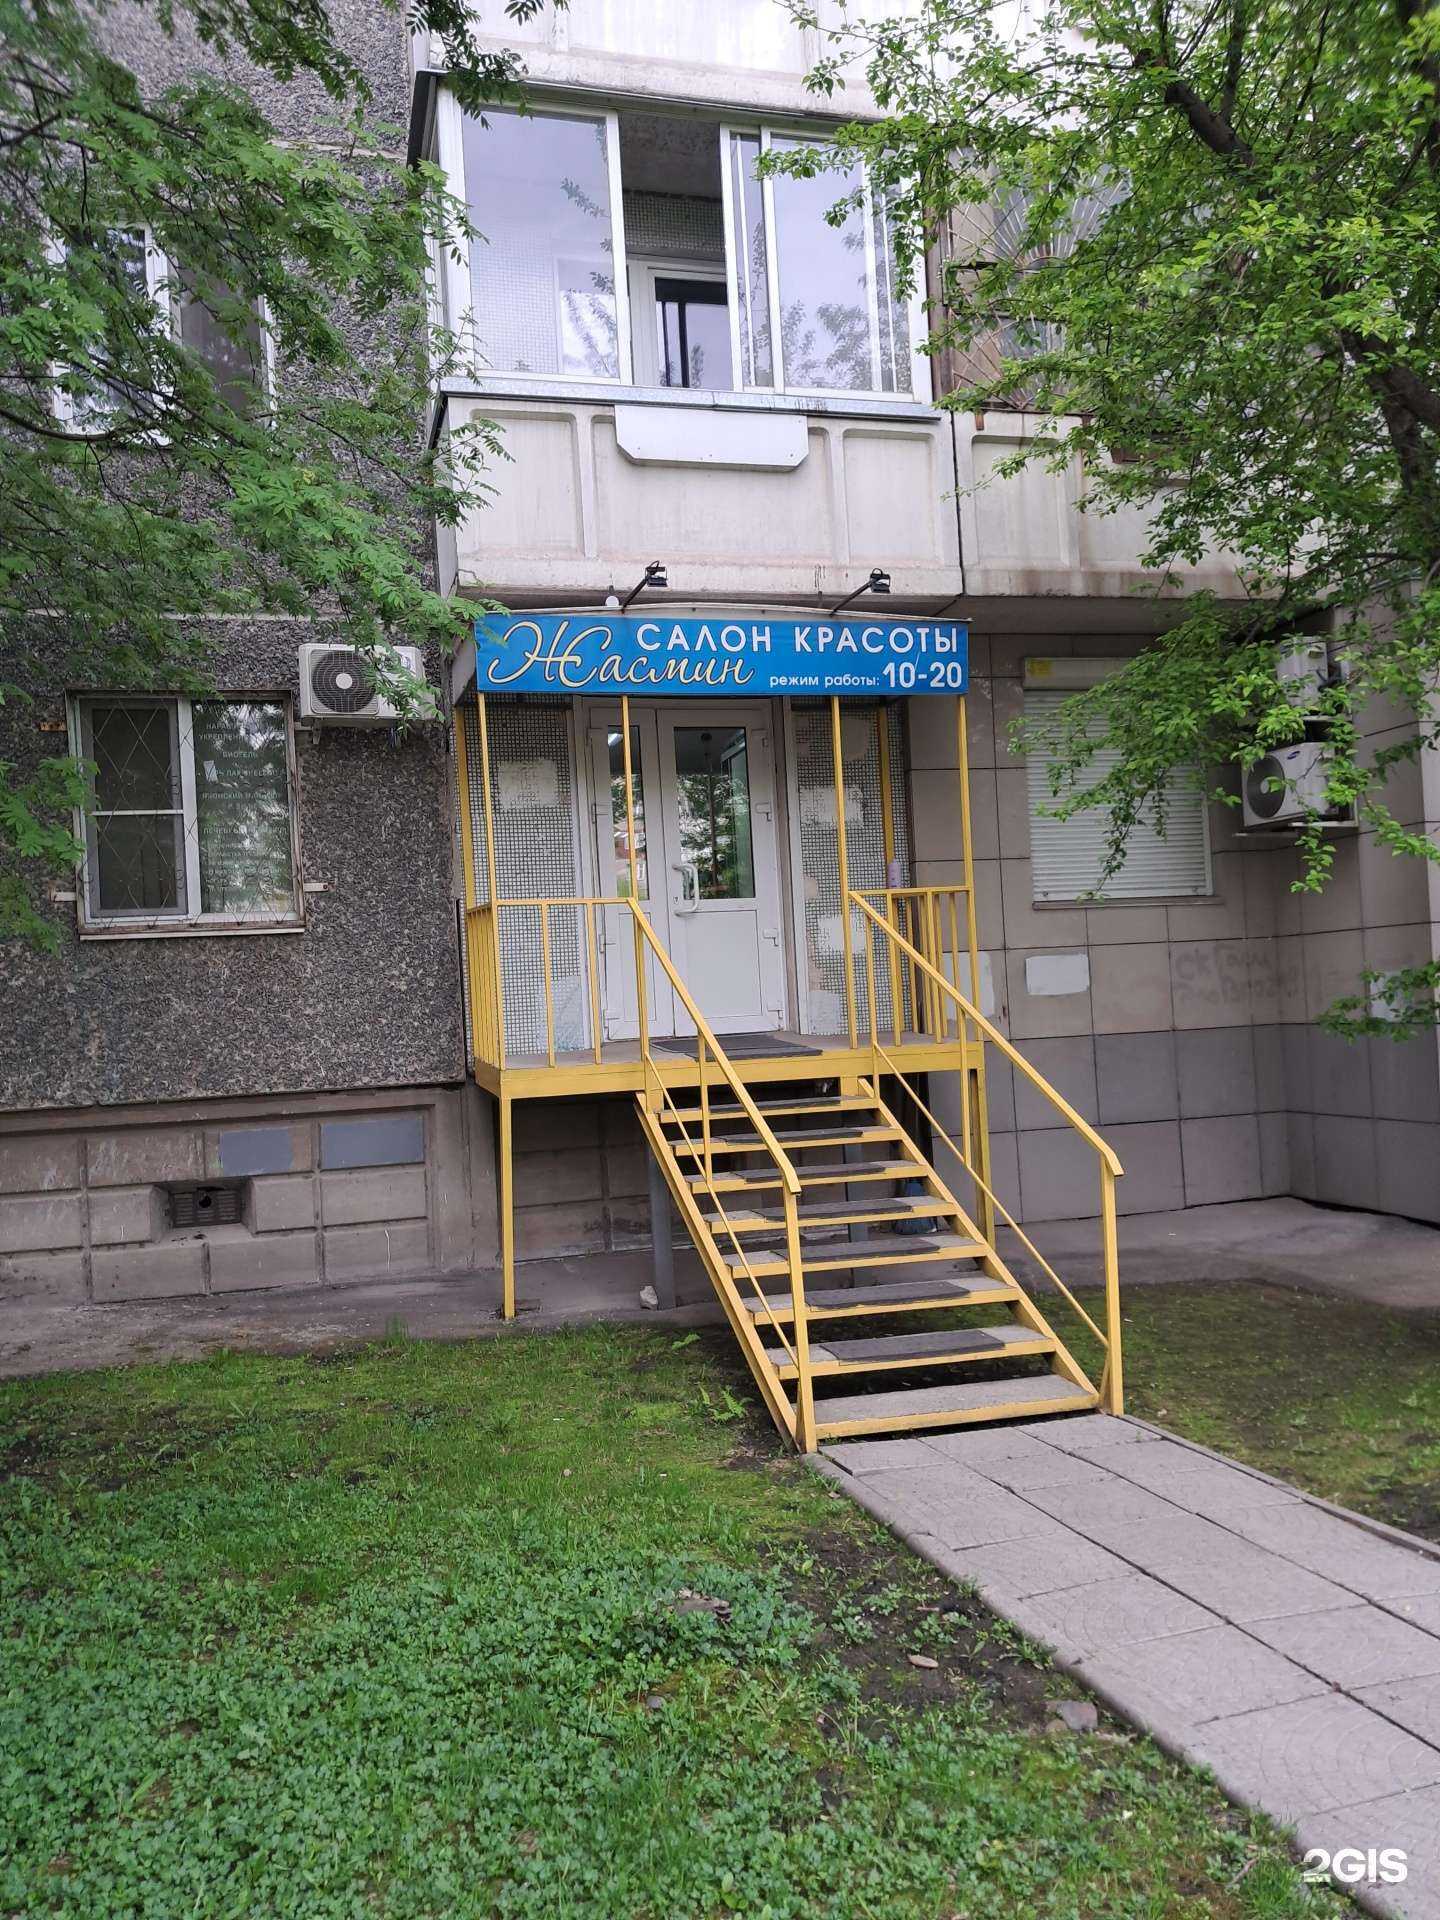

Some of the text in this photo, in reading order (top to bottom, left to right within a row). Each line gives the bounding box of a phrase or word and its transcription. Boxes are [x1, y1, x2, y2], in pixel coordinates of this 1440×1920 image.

[636, 623, 958, 653] САЛОН КРАСОТЫ
[487, 619, 755, 688] Жасмин
[770, 661, 962, 688] режим работы: 10-20
